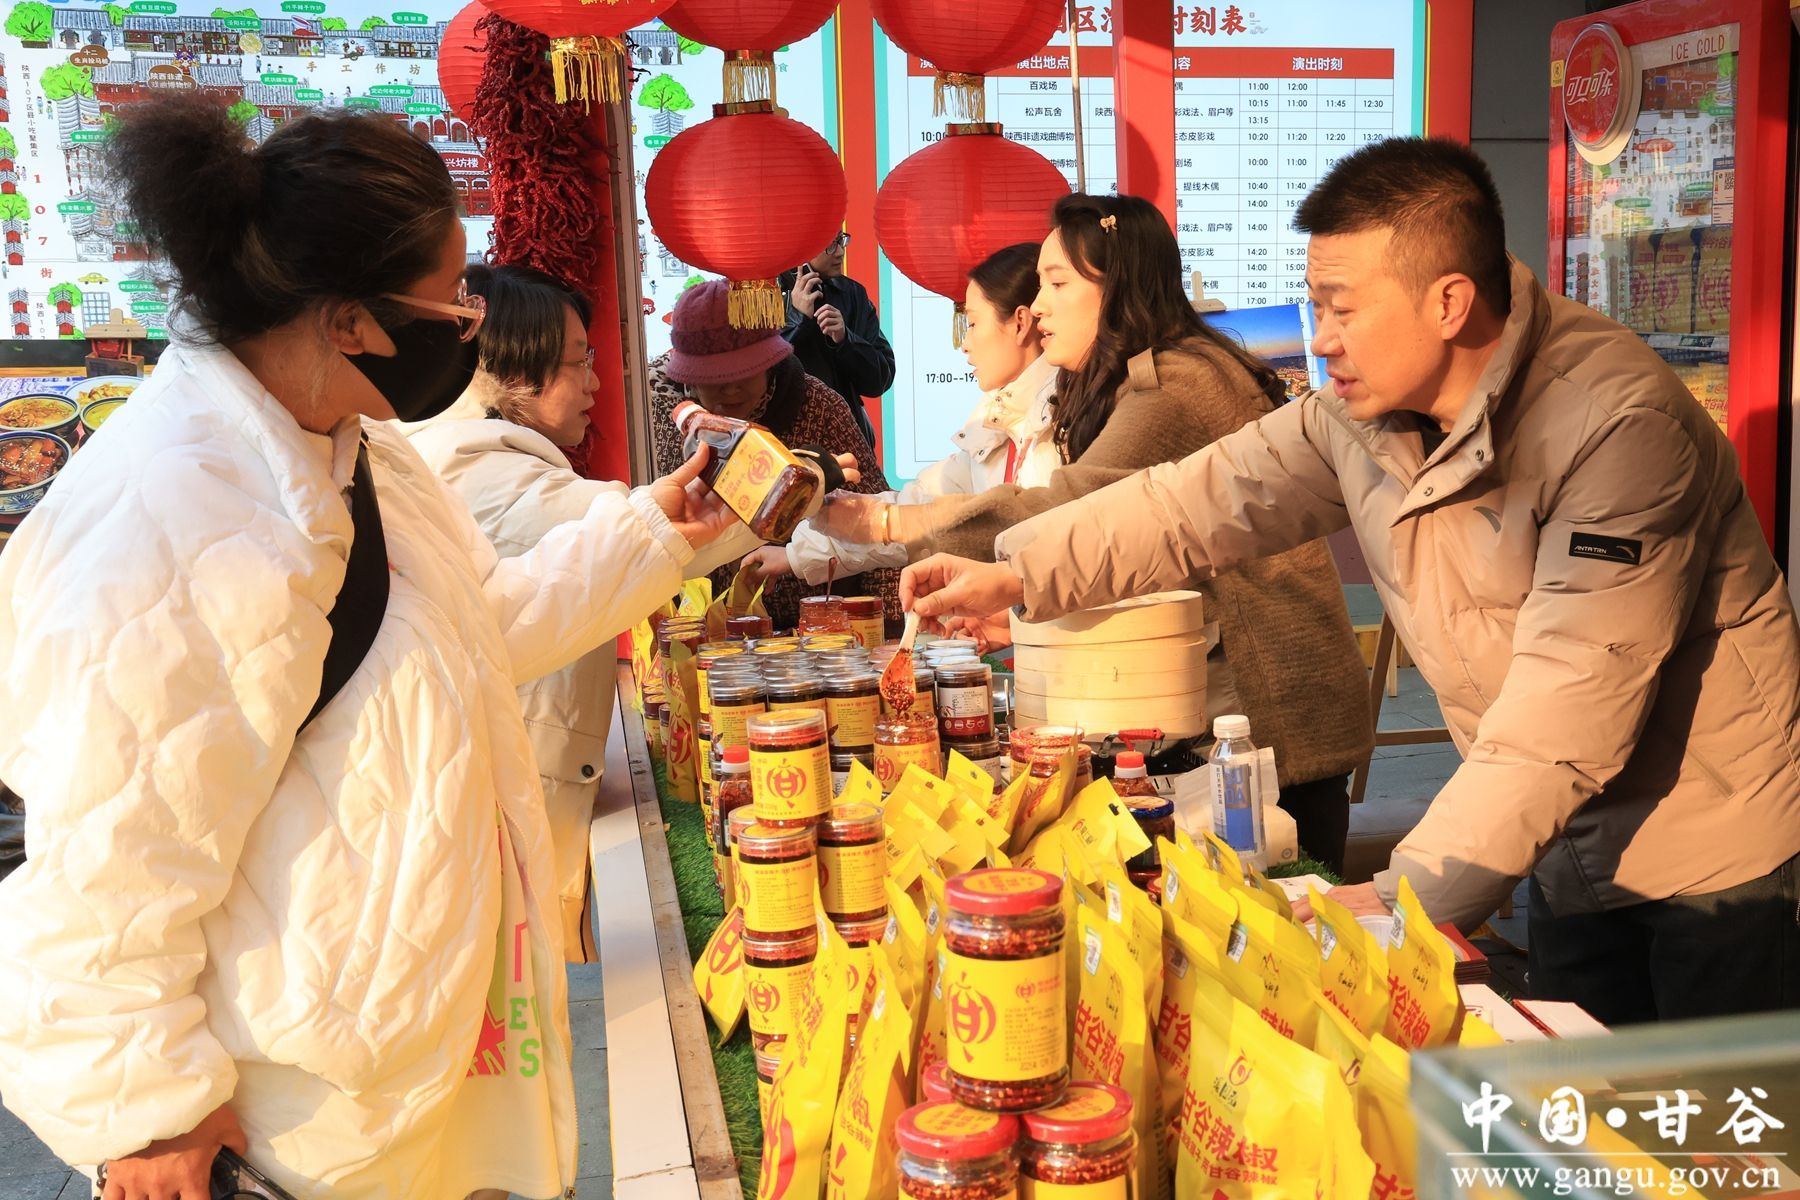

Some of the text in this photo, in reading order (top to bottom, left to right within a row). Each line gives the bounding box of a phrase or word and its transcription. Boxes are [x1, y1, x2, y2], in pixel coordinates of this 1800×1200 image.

[1671, 34, 1725, 61] ICE COLD
[1292, 57, 1343, 71] 演出时刻
[1029, 81, 1058, 91] 百戏场
[1248, 83, 1269, 91] 11:00
[1287, 83, 1308, 91] 12:00
[1566, 67, 1617, 106] 可口可乐
[1248, 99, 1269, 107] 10:15
[1287, 99, 1308, 107] 11:00
[1326, 100, 1346, 108] 11:45
[1363, 100, 1384, 108] 12:30
[1025, 107, 1062, 117] 松声瓦舍
[1248, 116, 1269, 124] 13:15
[1004, 131, 1076, 142] 陕西非遗戏曲博物
[1248, 133, 1269, 141] 10:20
[1287, 133, 1307, 141] 11:20
[1325, 133, 1346, 141] 12:20
[1363, 133, 1384, 141] 13:20
[1248, 158, 1269, 166] 10:00
[1287, 158, 1307, 166] 11:00
[1247, 182, 1268, 190] 10:40
[1286, 182, 1307, 190] 11:40
[1247, 200, 1268, 208] 14:00
[1247, 223, 1268, 231] 14:00
[1247, 248, 1268, 256] 14:20
[1285, 248, 1306, 256] 15:20
[1247, 264, 1267, 272] 14:00
[1285, 264, 1306, 272] 15:00
[1183, 280, 1219, 290] 提木偶
[1247, 281, 1267, 289] 14:40
[1285, 281, 1305, 289] 15:40
[1246, 297, 1267, 305] 17:00
[1285, 297, 1305, 305] 18:00
[1183, 1082, 1279, 1172] 甘谷辣椒
